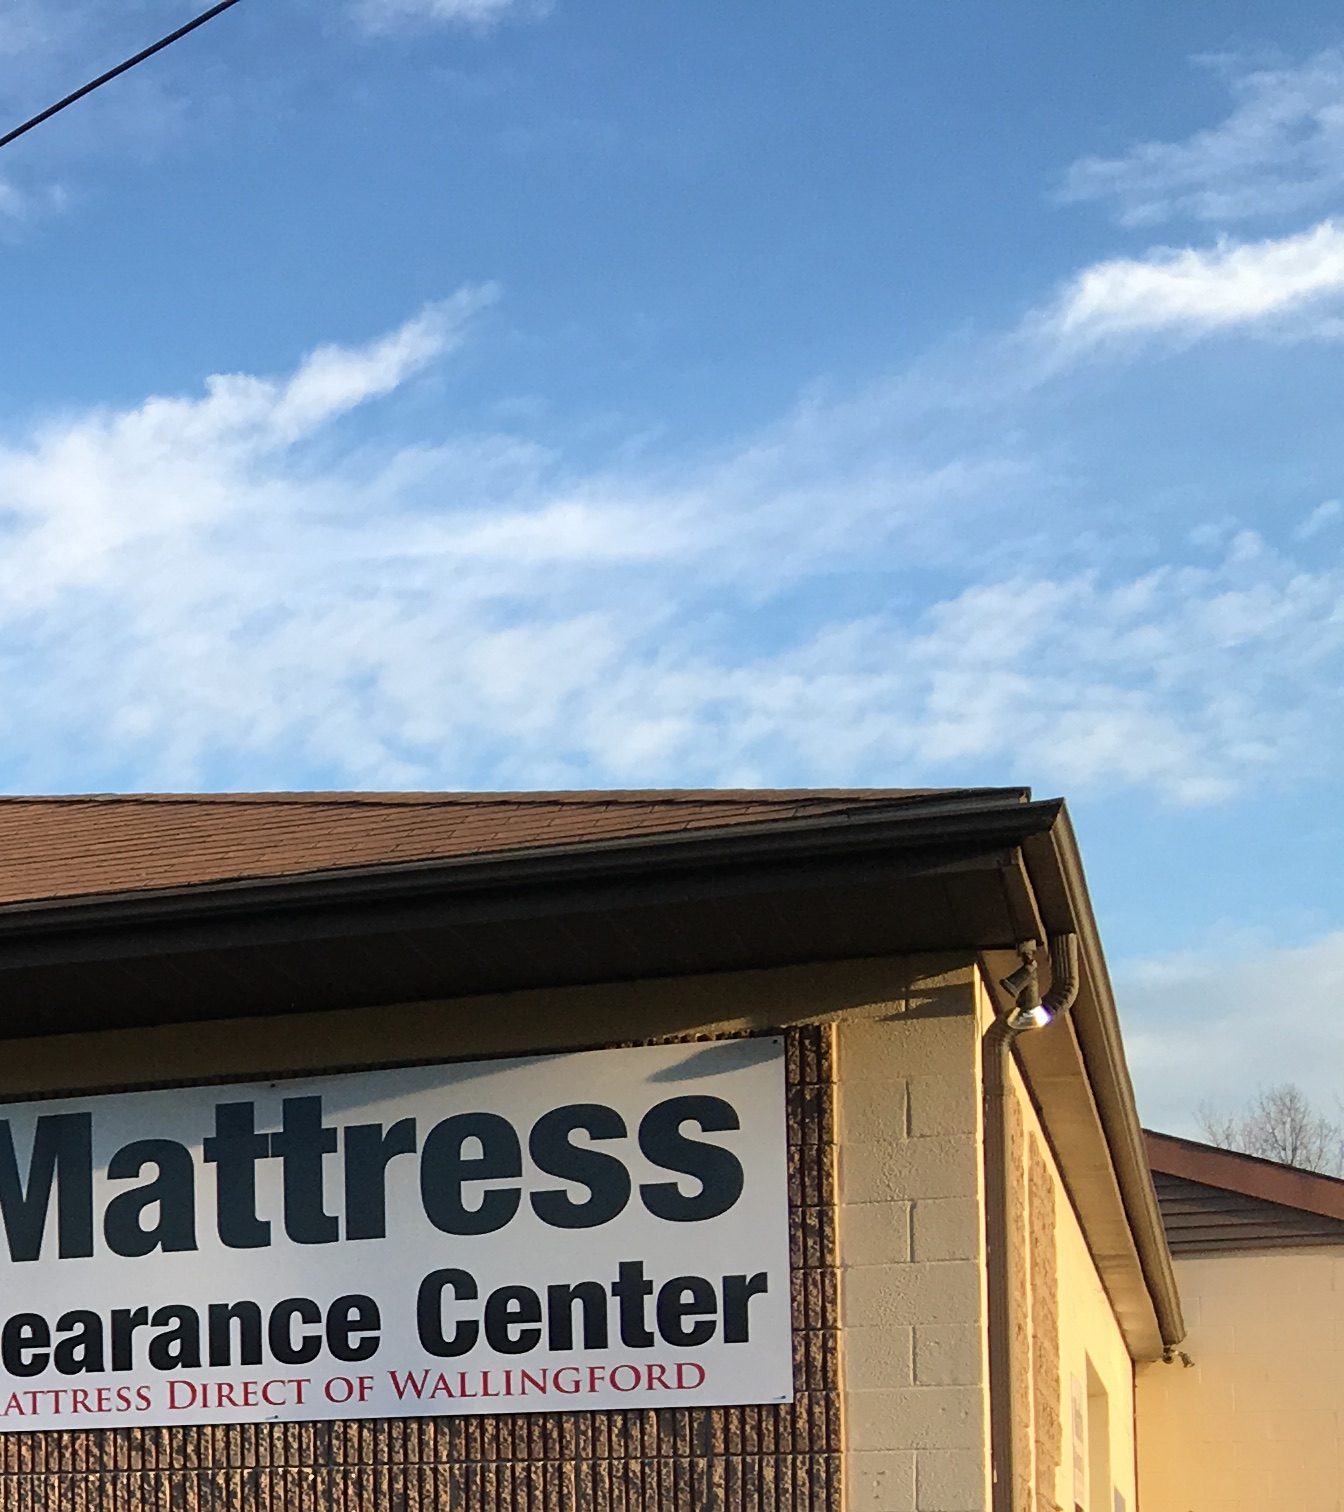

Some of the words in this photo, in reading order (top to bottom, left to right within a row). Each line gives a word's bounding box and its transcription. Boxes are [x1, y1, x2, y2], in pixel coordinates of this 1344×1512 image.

[416, 1260, 768, 1358] Center
[165, 1378, 312, 1411] DIRECT
[324, 1375, 375, 1404] OF
[387, 1361, 707, 1402] WALLINGFORD
